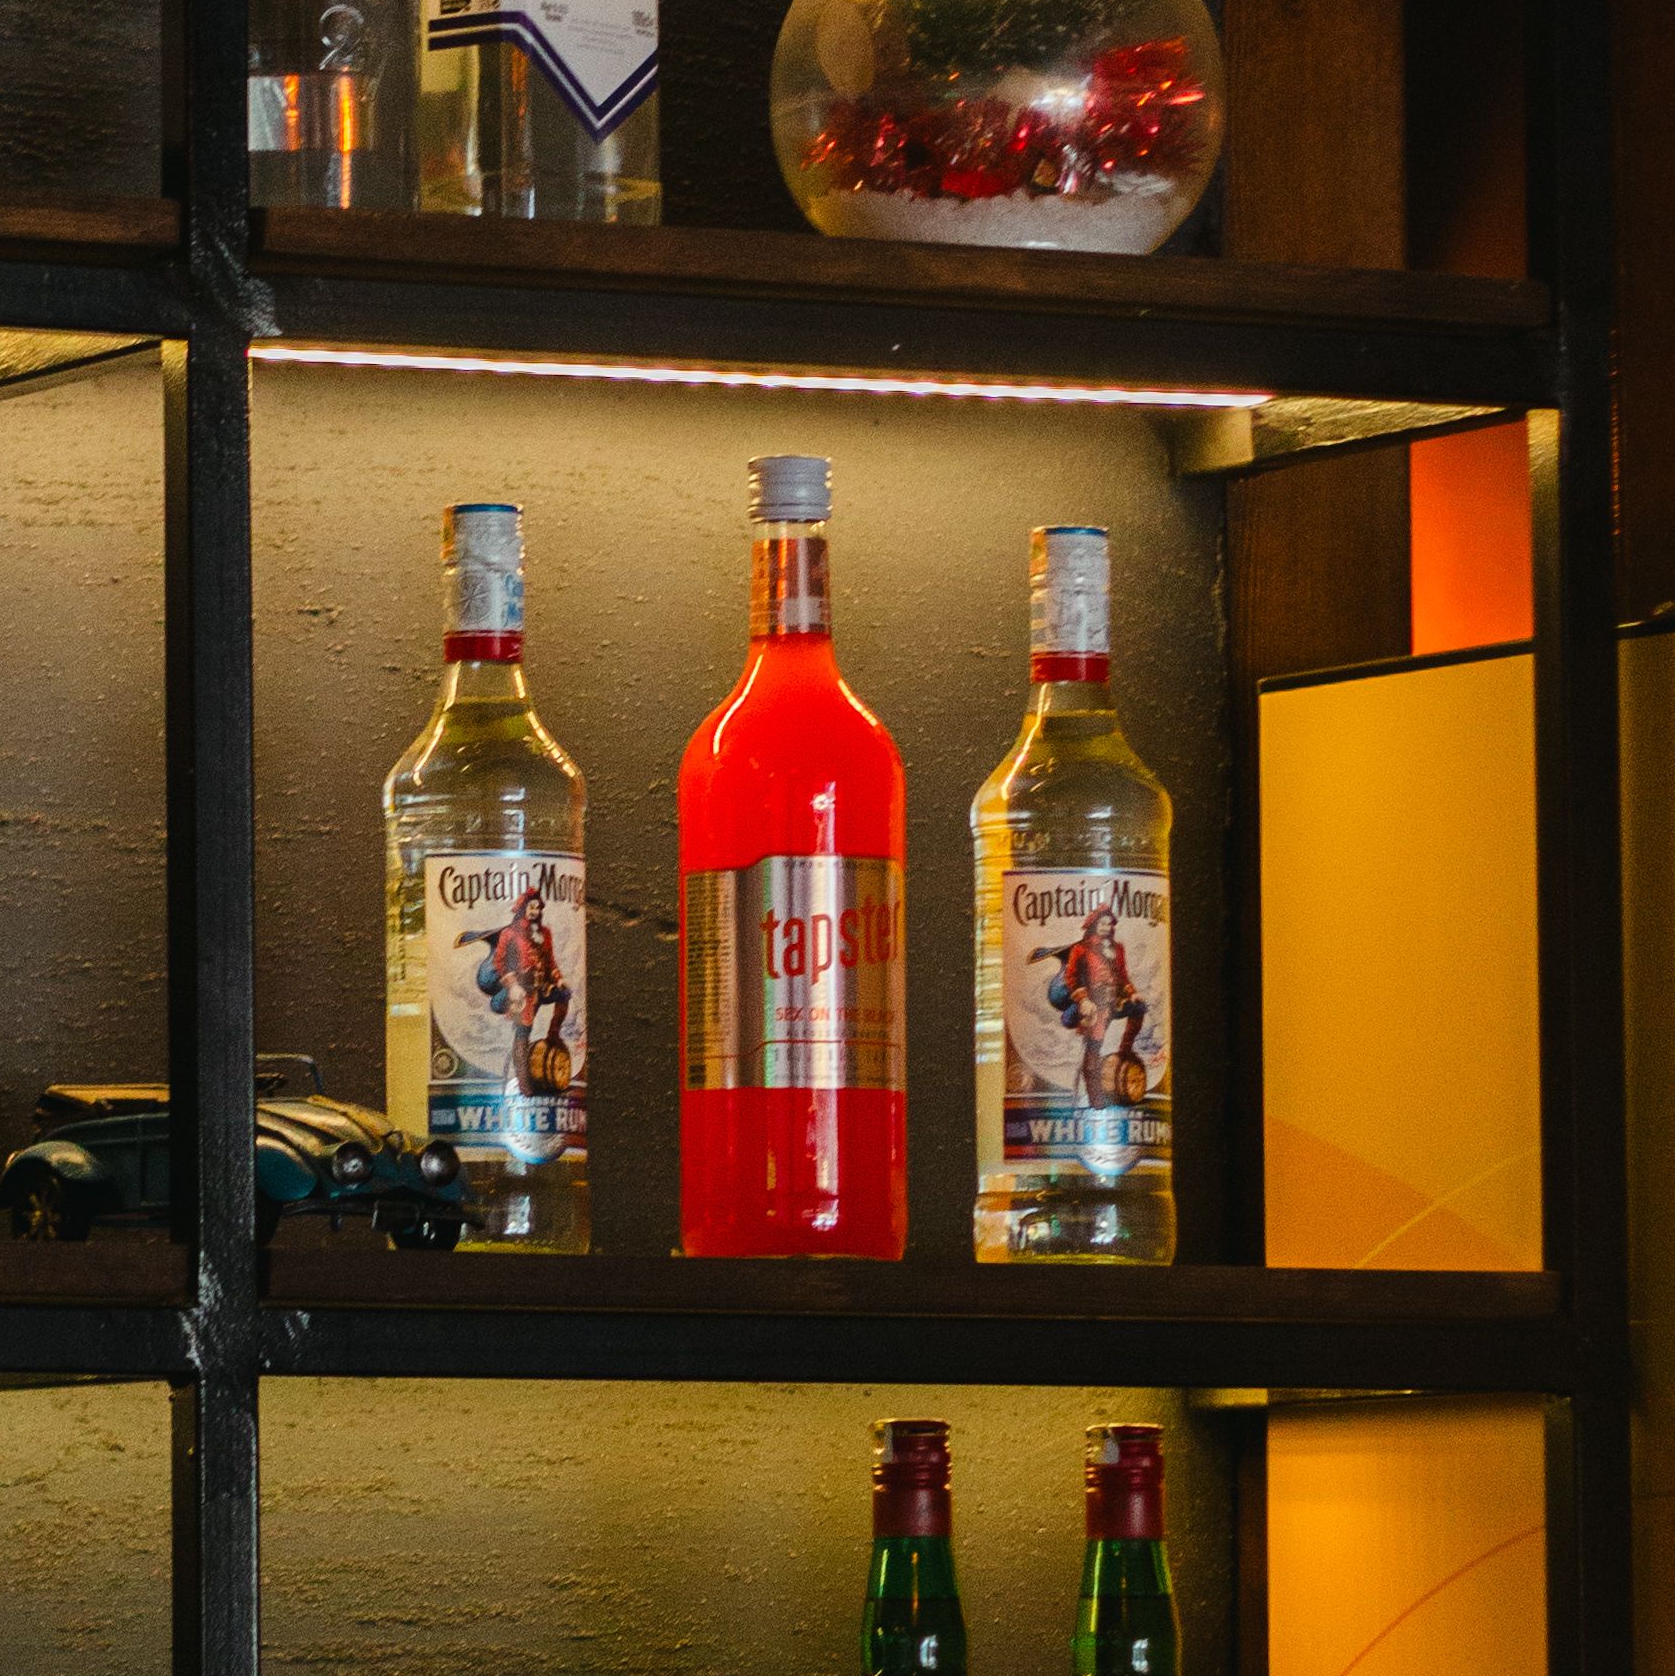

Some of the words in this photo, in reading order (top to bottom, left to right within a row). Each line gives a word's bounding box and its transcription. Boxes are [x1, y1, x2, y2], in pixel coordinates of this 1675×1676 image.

[438, 863, 531, 910] Captain
[1013, 882, 1103, 927] Captain
[758, 893, 901, 987] tapster
[774, 1007, 804, 1022] SEX
[456, 1106, 550, 1133] WHITE
[1028, 1119, 1122, 1145] WHITE
